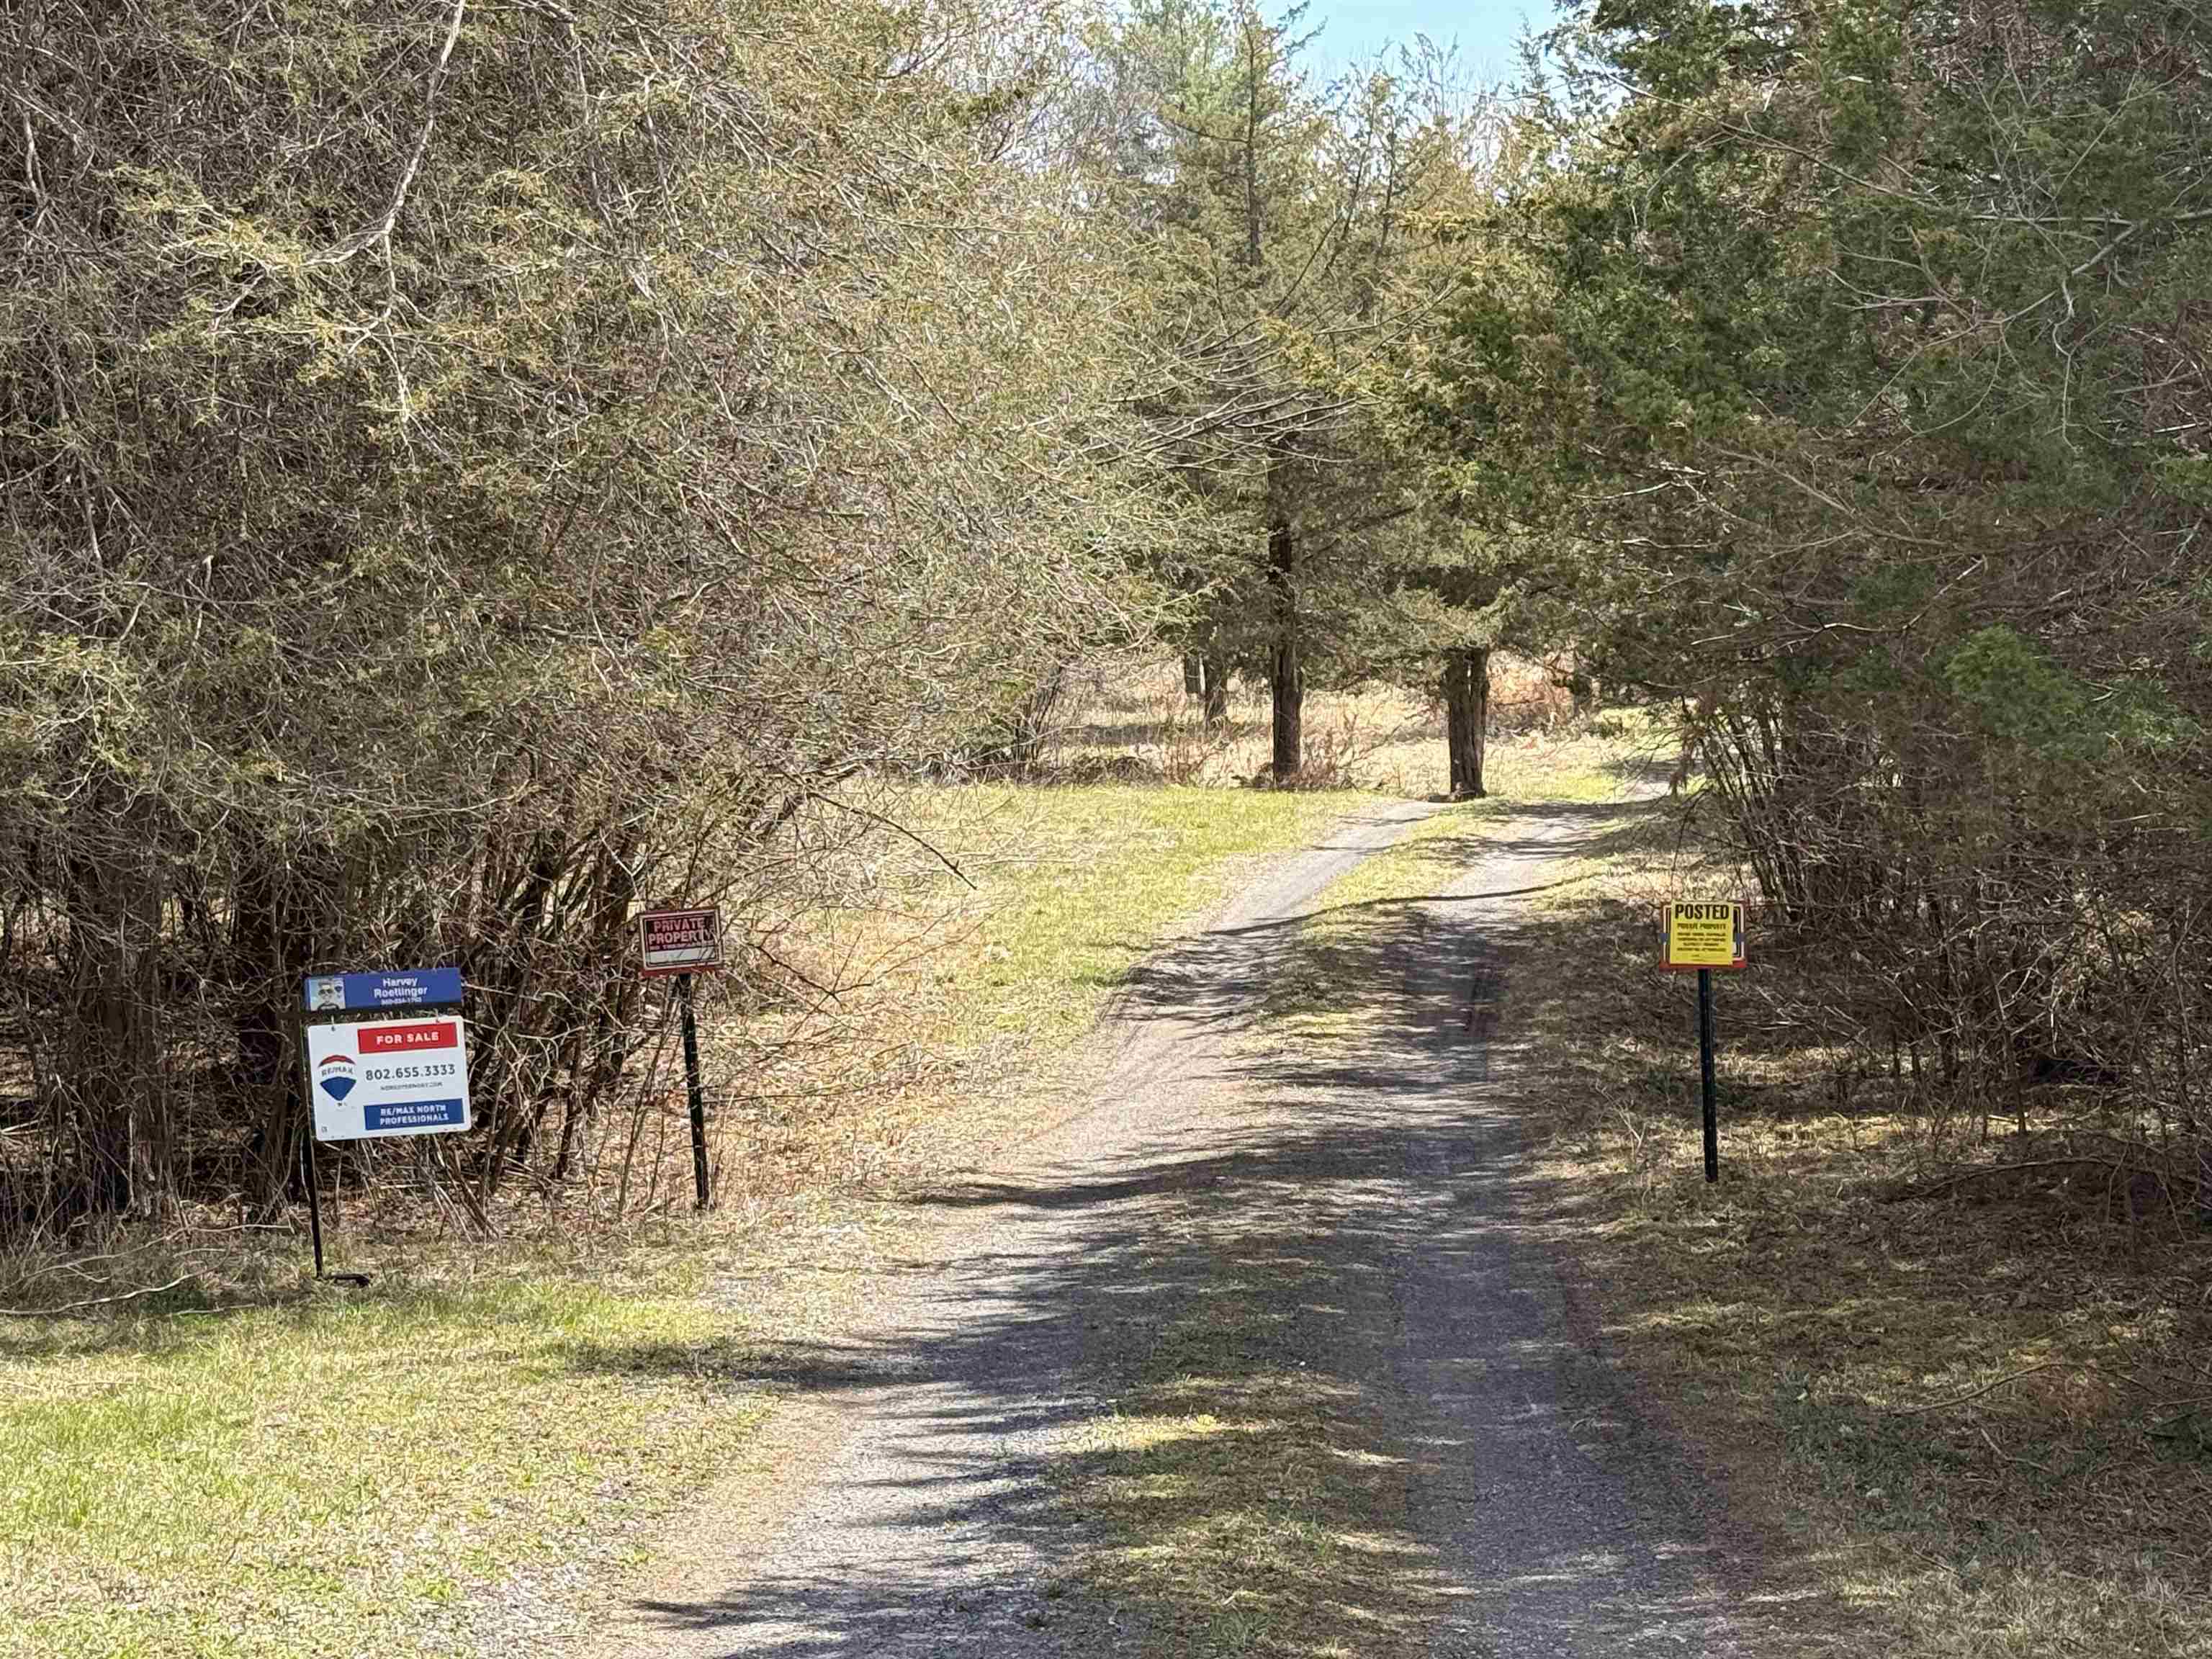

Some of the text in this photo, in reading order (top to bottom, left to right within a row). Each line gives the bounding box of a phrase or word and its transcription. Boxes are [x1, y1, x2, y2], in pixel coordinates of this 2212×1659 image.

[1675, 904, 1729, 919] POSTED
[653, 917, 704, 932] PRIVATE
[648, 929, 714, 945] PROPERTY
[382, 978, 418, 986] Harvey
[377, 1031, 439, 1045] FOR SALE
[322, 1067, 353, 1076] RE/MAX
[366, 1064, 455, 1080] 802.655.3333
[380, 1104, 446, 1115] RE/MAX NORTH
[379, 1113, 449, 1125] PROFESSIONALS
